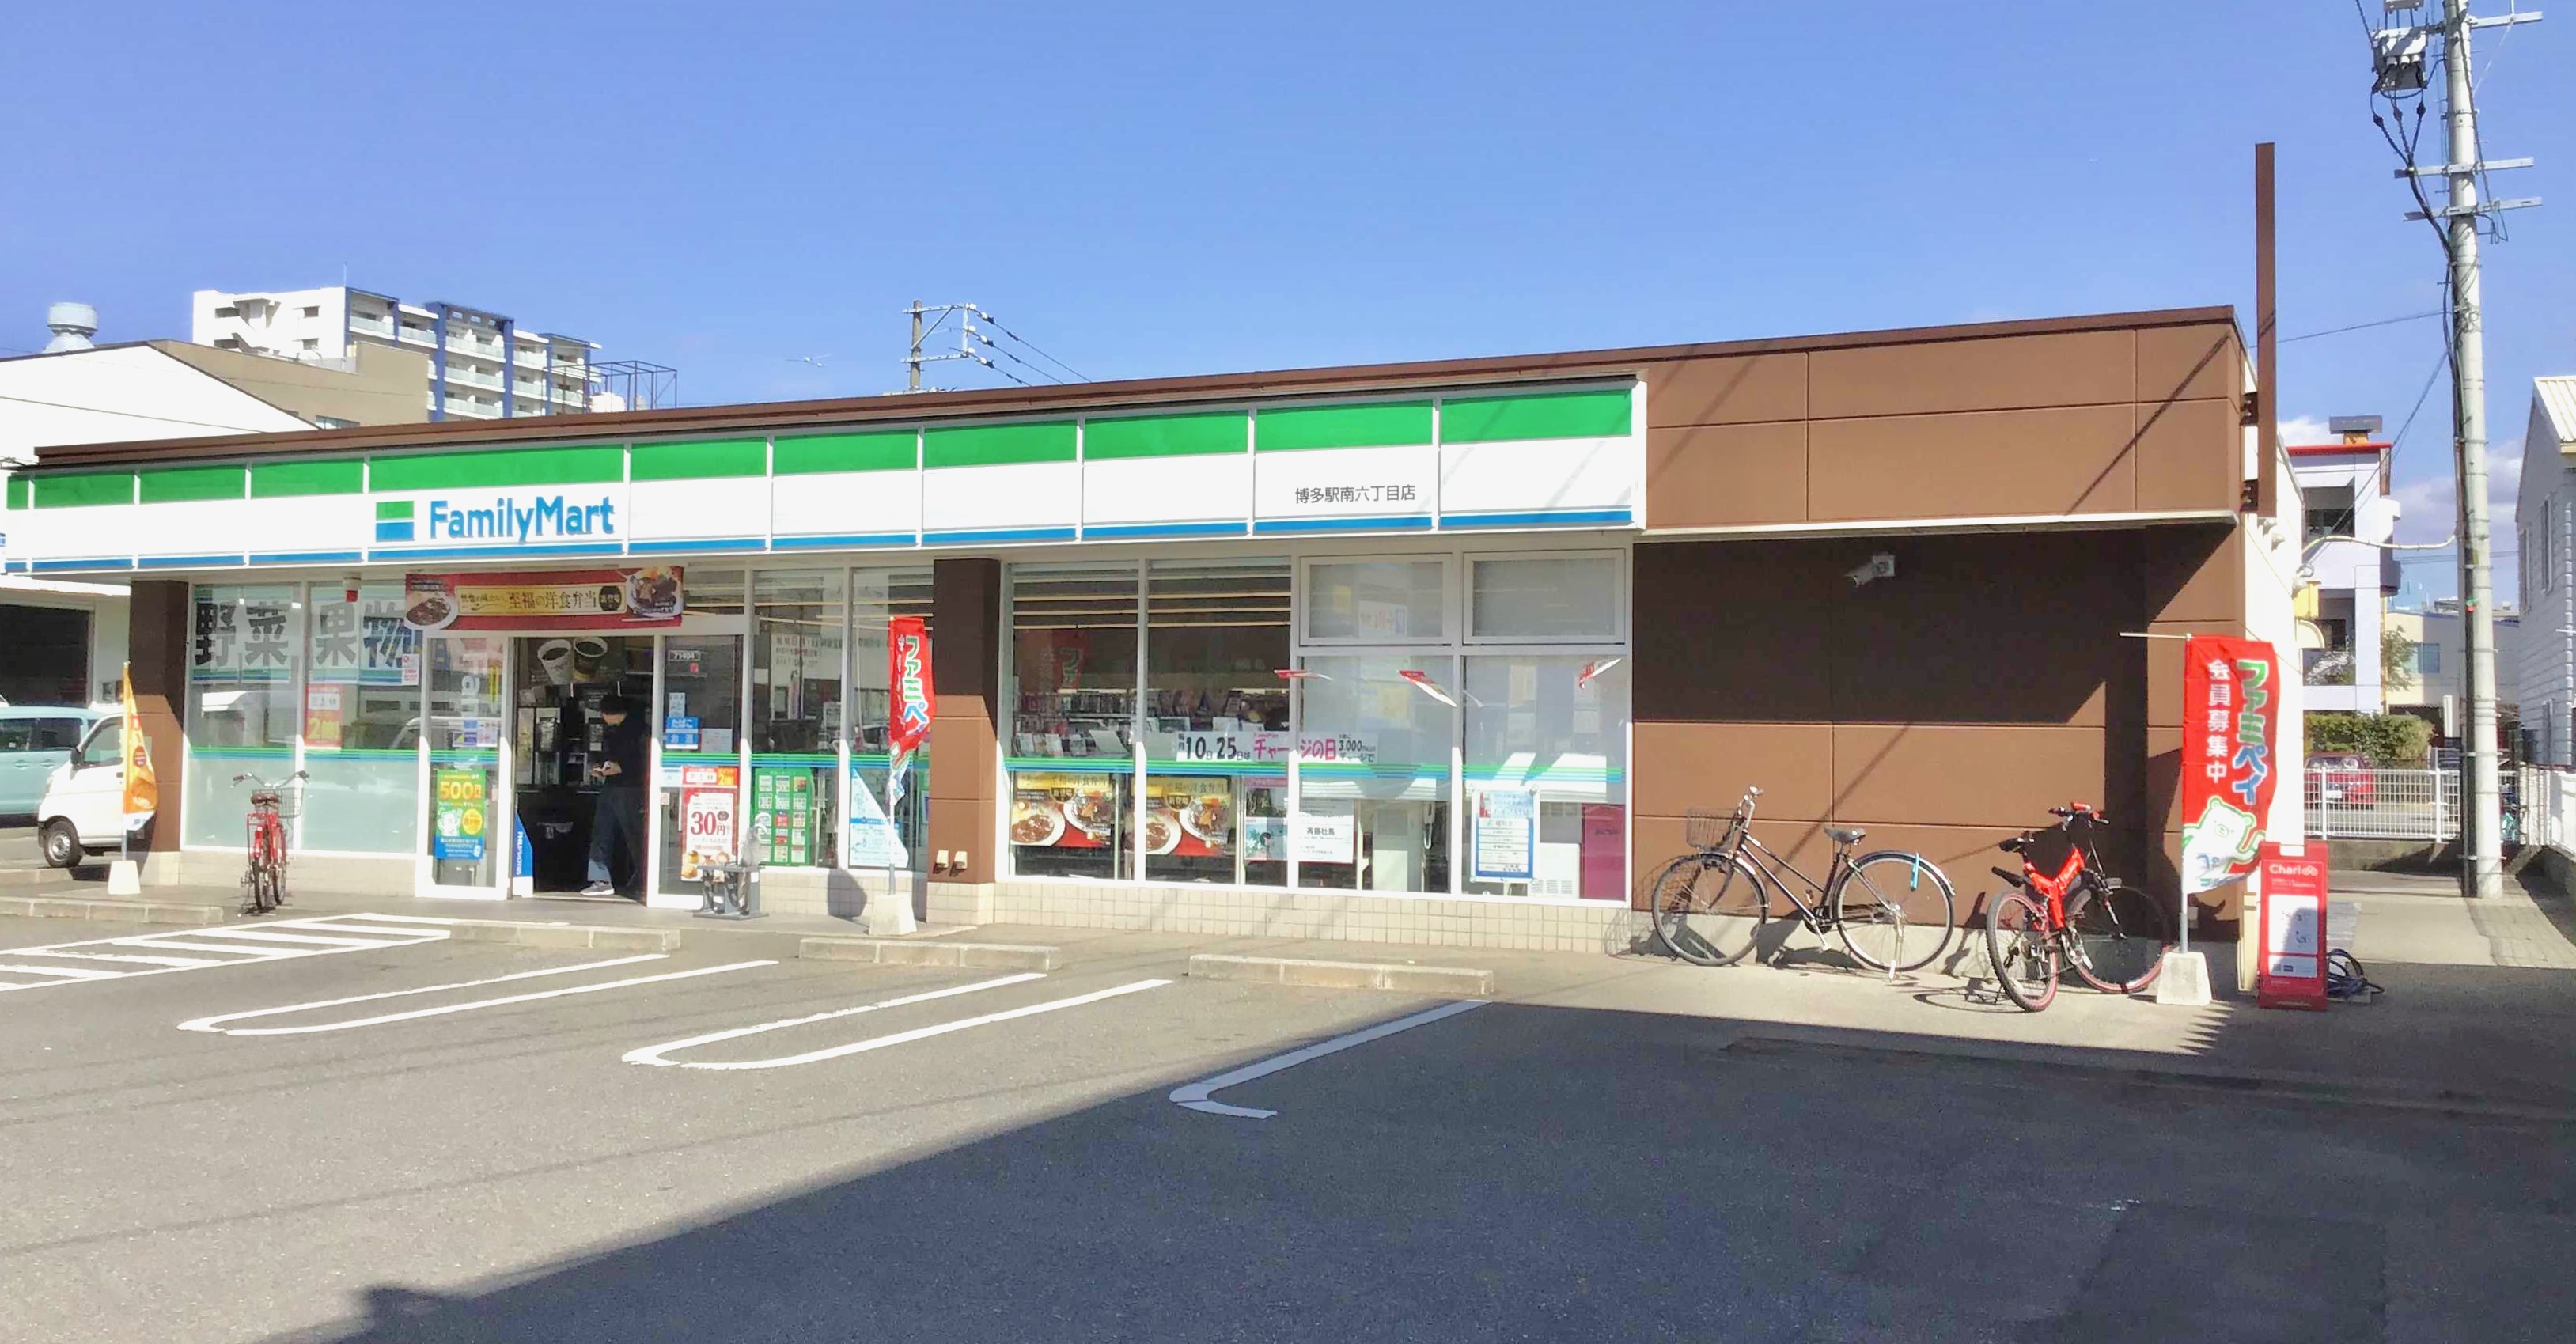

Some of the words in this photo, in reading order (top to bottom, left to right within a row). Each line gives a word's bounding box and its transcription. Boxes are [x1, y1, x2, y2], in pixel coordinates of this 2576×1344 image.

[430, 496, 615, 544] FamilyMart
[1295, 484, 1416, 504] 博多駅南六丁目店
[2206, 658, 2230, 784] 会員募集中
[2231, 659, 2269, 805] ファミペイ
